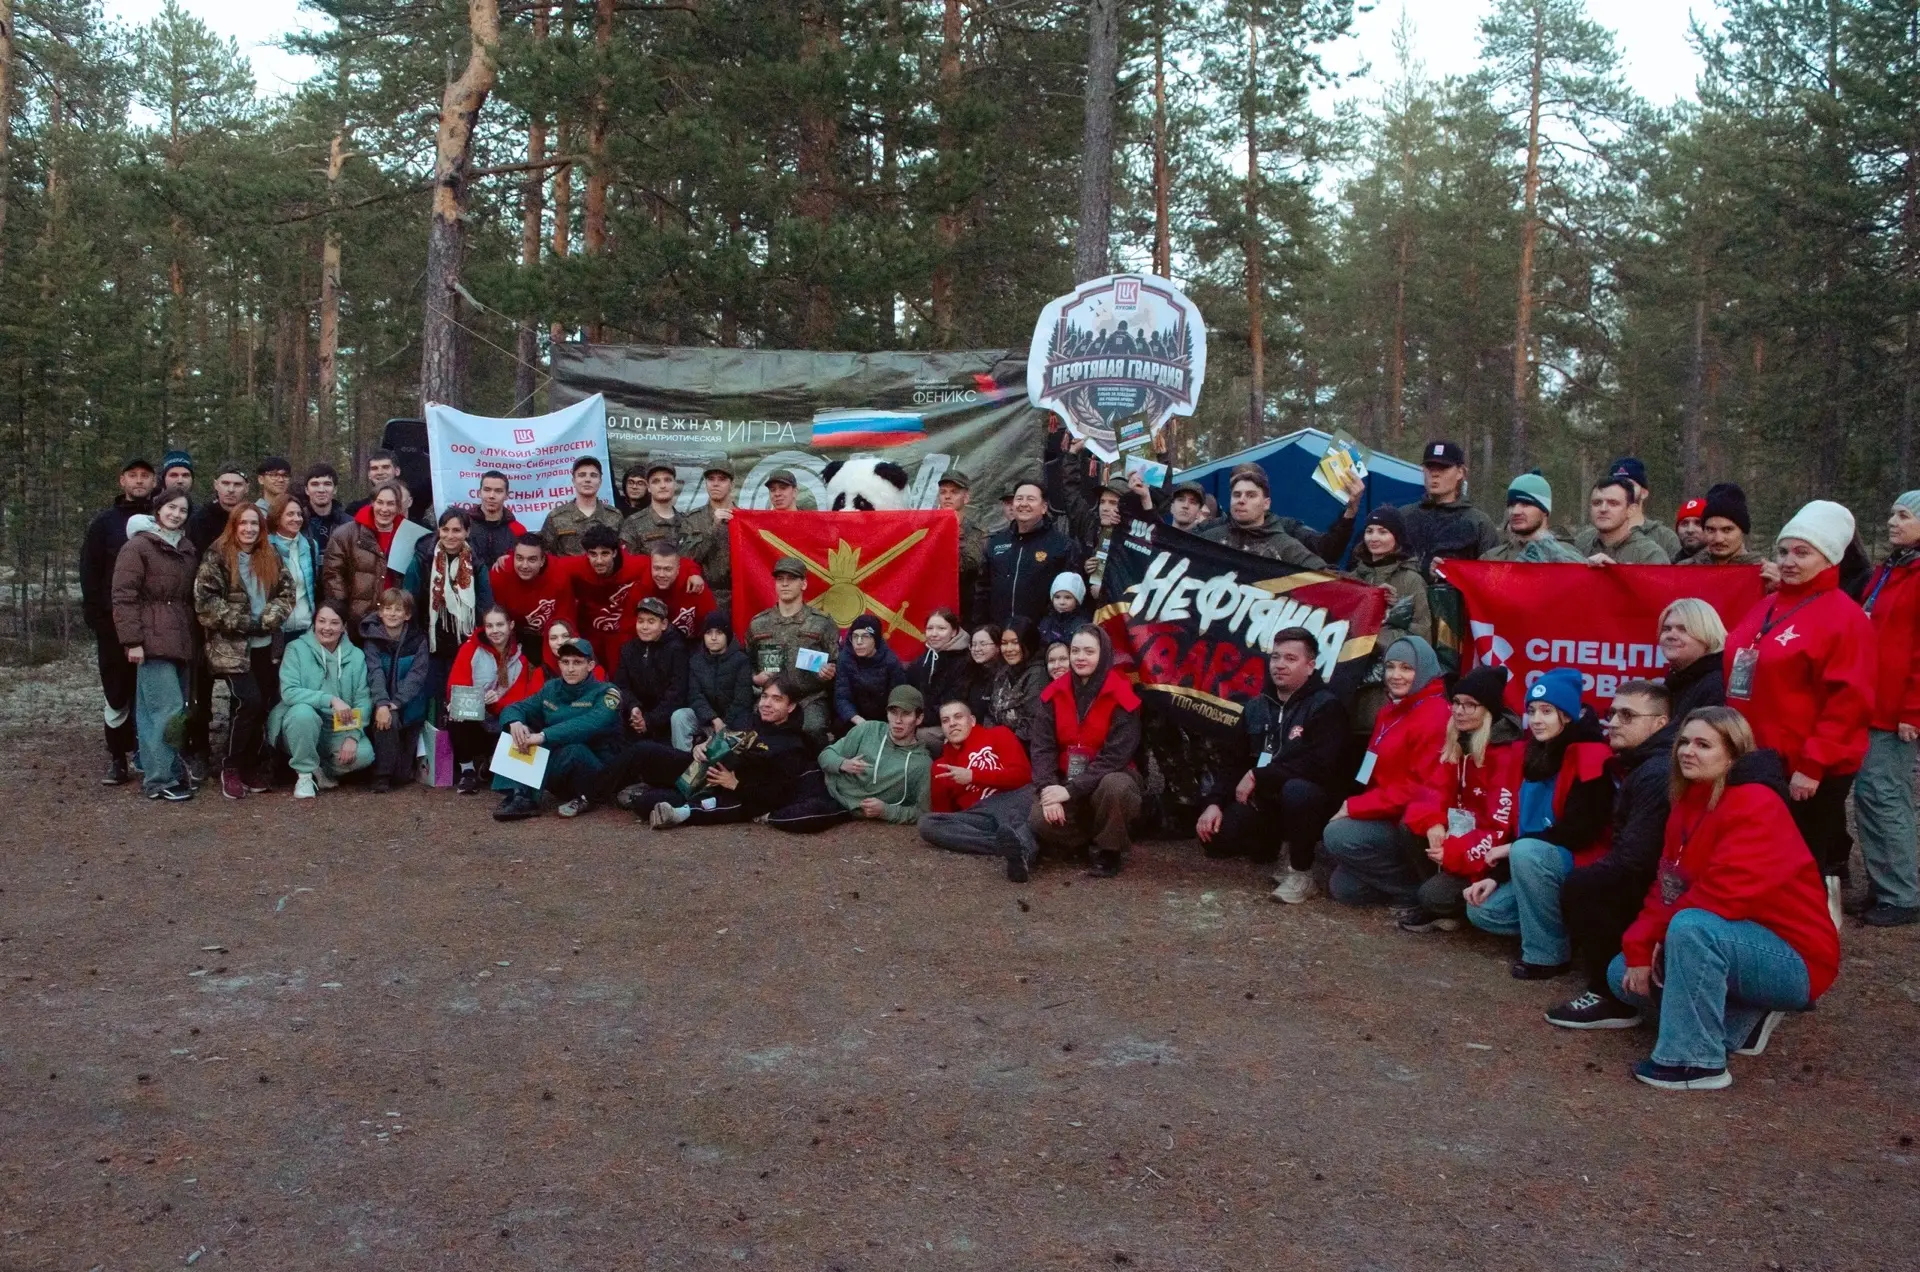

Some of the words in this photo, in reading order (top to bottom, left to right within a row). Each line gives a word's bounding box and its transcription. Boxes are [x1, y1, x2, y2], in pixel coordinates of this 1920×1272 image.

[1051, 359, 1125, 387] НЕФТЯНАЯ
[1127, 359, 1184, 391] ГВАРДИЯ
[912, 389, 977, 404] ФЕНИКС
[607, 416, 723, 431] ОЛОДЁЖНАЯ
[607, 432, 722, 442] РТИВНО-ПАТРИОТИЧЕСКАЯ
[727, 420, 796, 442] ИГРА
[450, 444, 476, 454] ООО
[475, 456, 576, 469] Западно-Сибирское
[549, 487, 576, 498] ЦЕН
